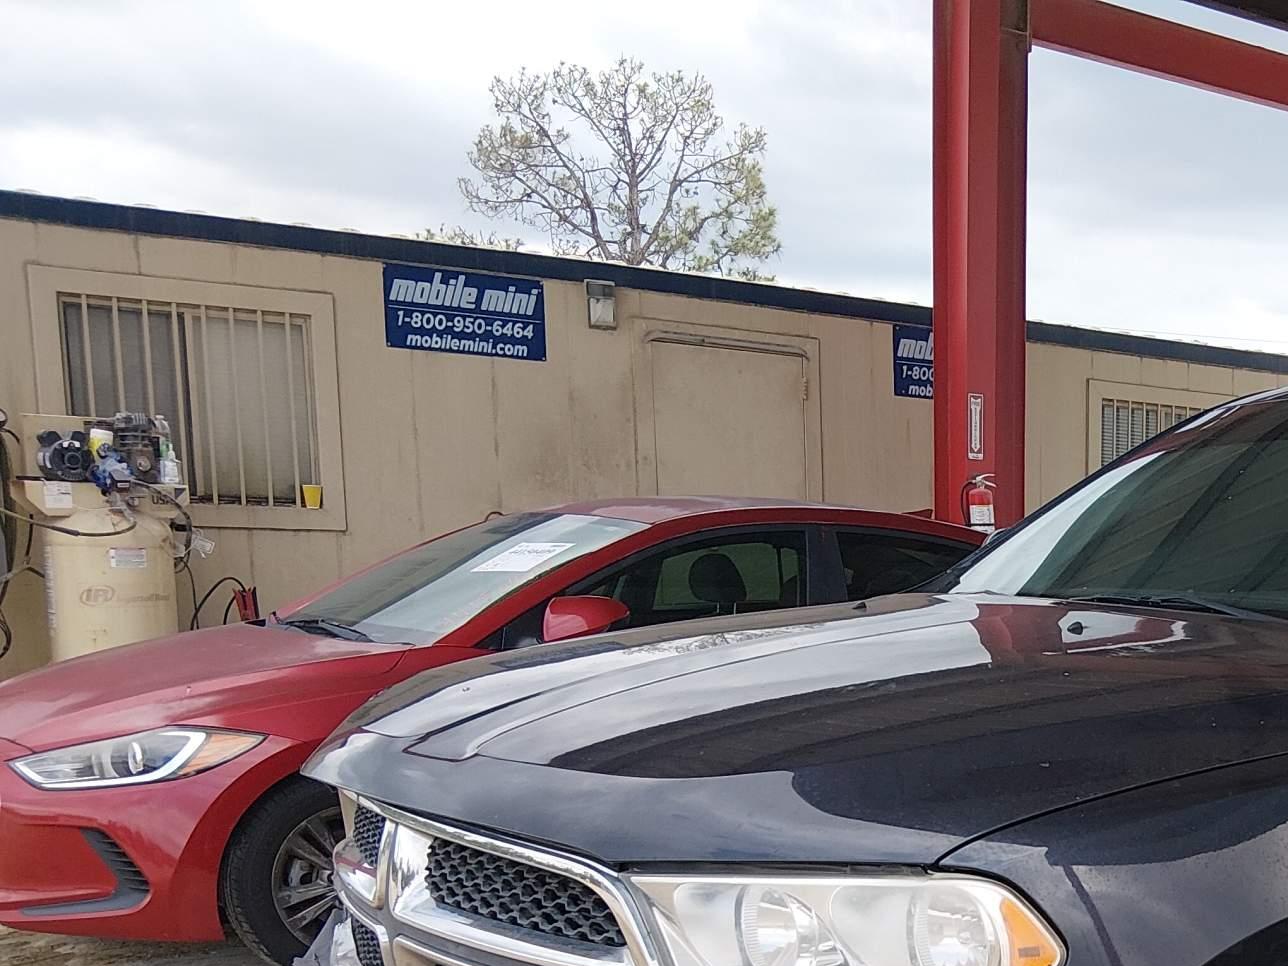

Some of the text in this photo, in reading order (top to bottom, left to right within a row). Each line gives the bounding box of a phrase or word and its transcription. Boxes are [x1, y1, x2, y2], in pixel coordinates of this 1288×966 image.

[388, 271, 539, 316] mobile mini
[397, 310, 534, 340] 1-800-950-6464
[406, 333, 528, 357] mobilemini.com
